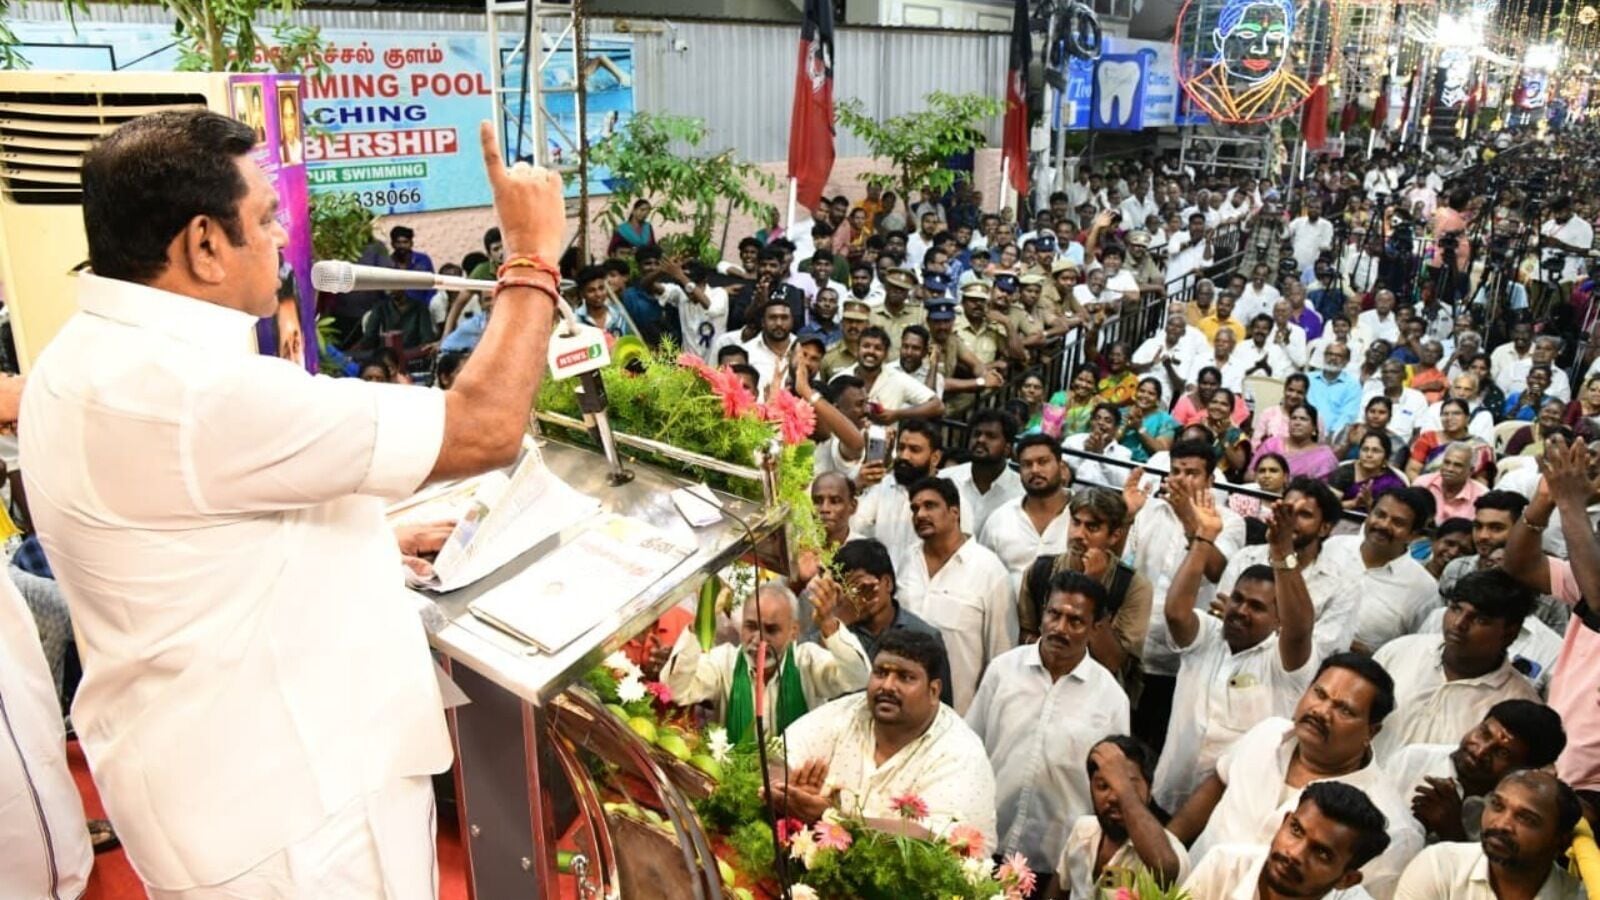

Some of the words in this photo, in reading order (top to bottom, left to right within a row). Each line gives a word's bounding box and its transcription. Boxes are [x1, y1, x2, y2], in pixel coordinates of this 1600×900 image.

[383, 42, 444, 69] குளம்
[411, 73, 492, 97] POOL
[305, 130, 456, 160] BERSHIP
[342, 164, 425, 182] SWIMMING
[559, 350, 587, 366] NEWS
